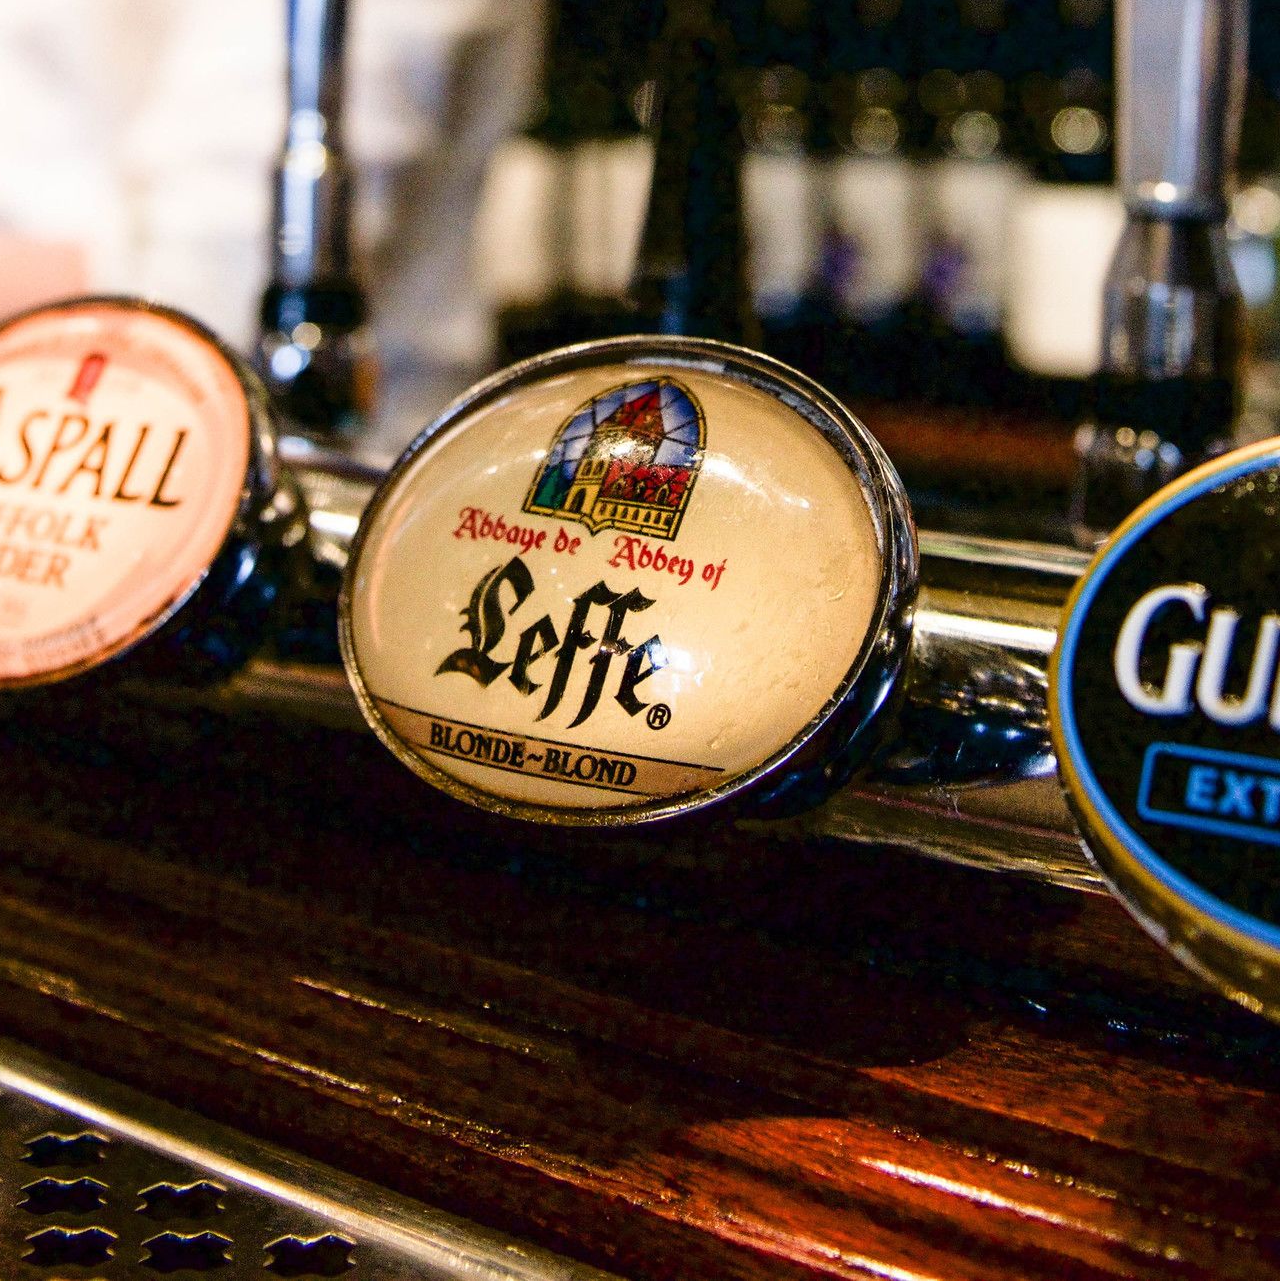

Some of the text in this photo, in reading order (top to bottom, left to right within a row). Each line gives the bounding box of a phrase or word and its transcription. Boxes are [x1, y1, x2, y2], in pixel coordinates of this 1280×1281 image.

[454, 506, 728, 591] Abbaye de Abbey of
